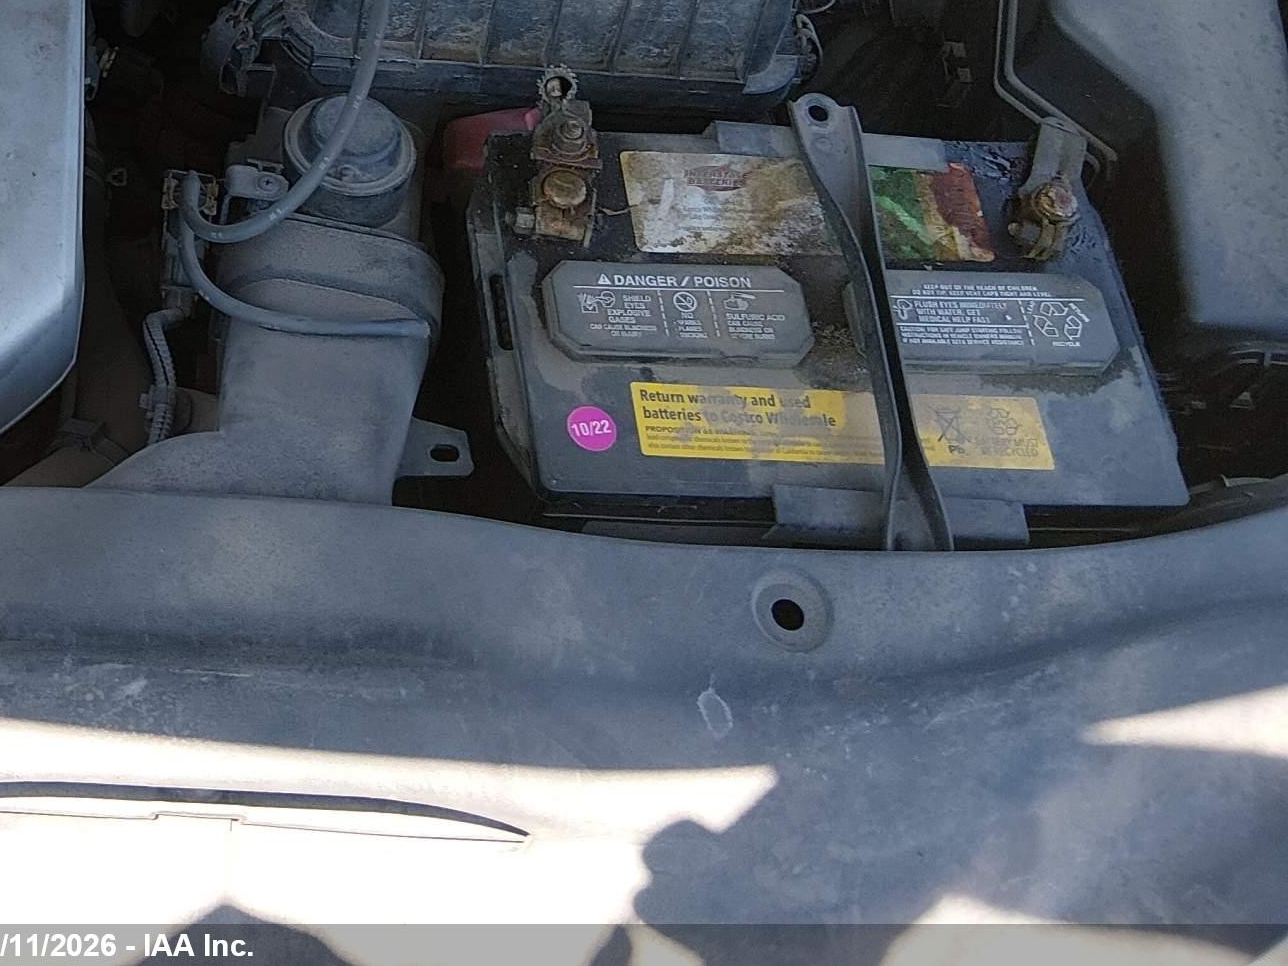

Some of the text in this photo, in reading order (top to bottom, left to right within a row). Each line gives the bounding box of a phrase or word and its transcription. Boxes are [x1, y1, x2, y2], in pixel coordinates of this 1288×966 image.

[613, 274, 677, 287] DANGER
[694, 276, 753, 288] POISON
[623, 302, 646, 310] EYES
[639, 389, 685, 404] Return
[687, 392, 748, 410] warranty
[750, 394, 776, 407] and
[642, 406, 702, 422] batteries
[720, 409, 763, 425] Costco
[571, 420, 612, 437] 10/22
